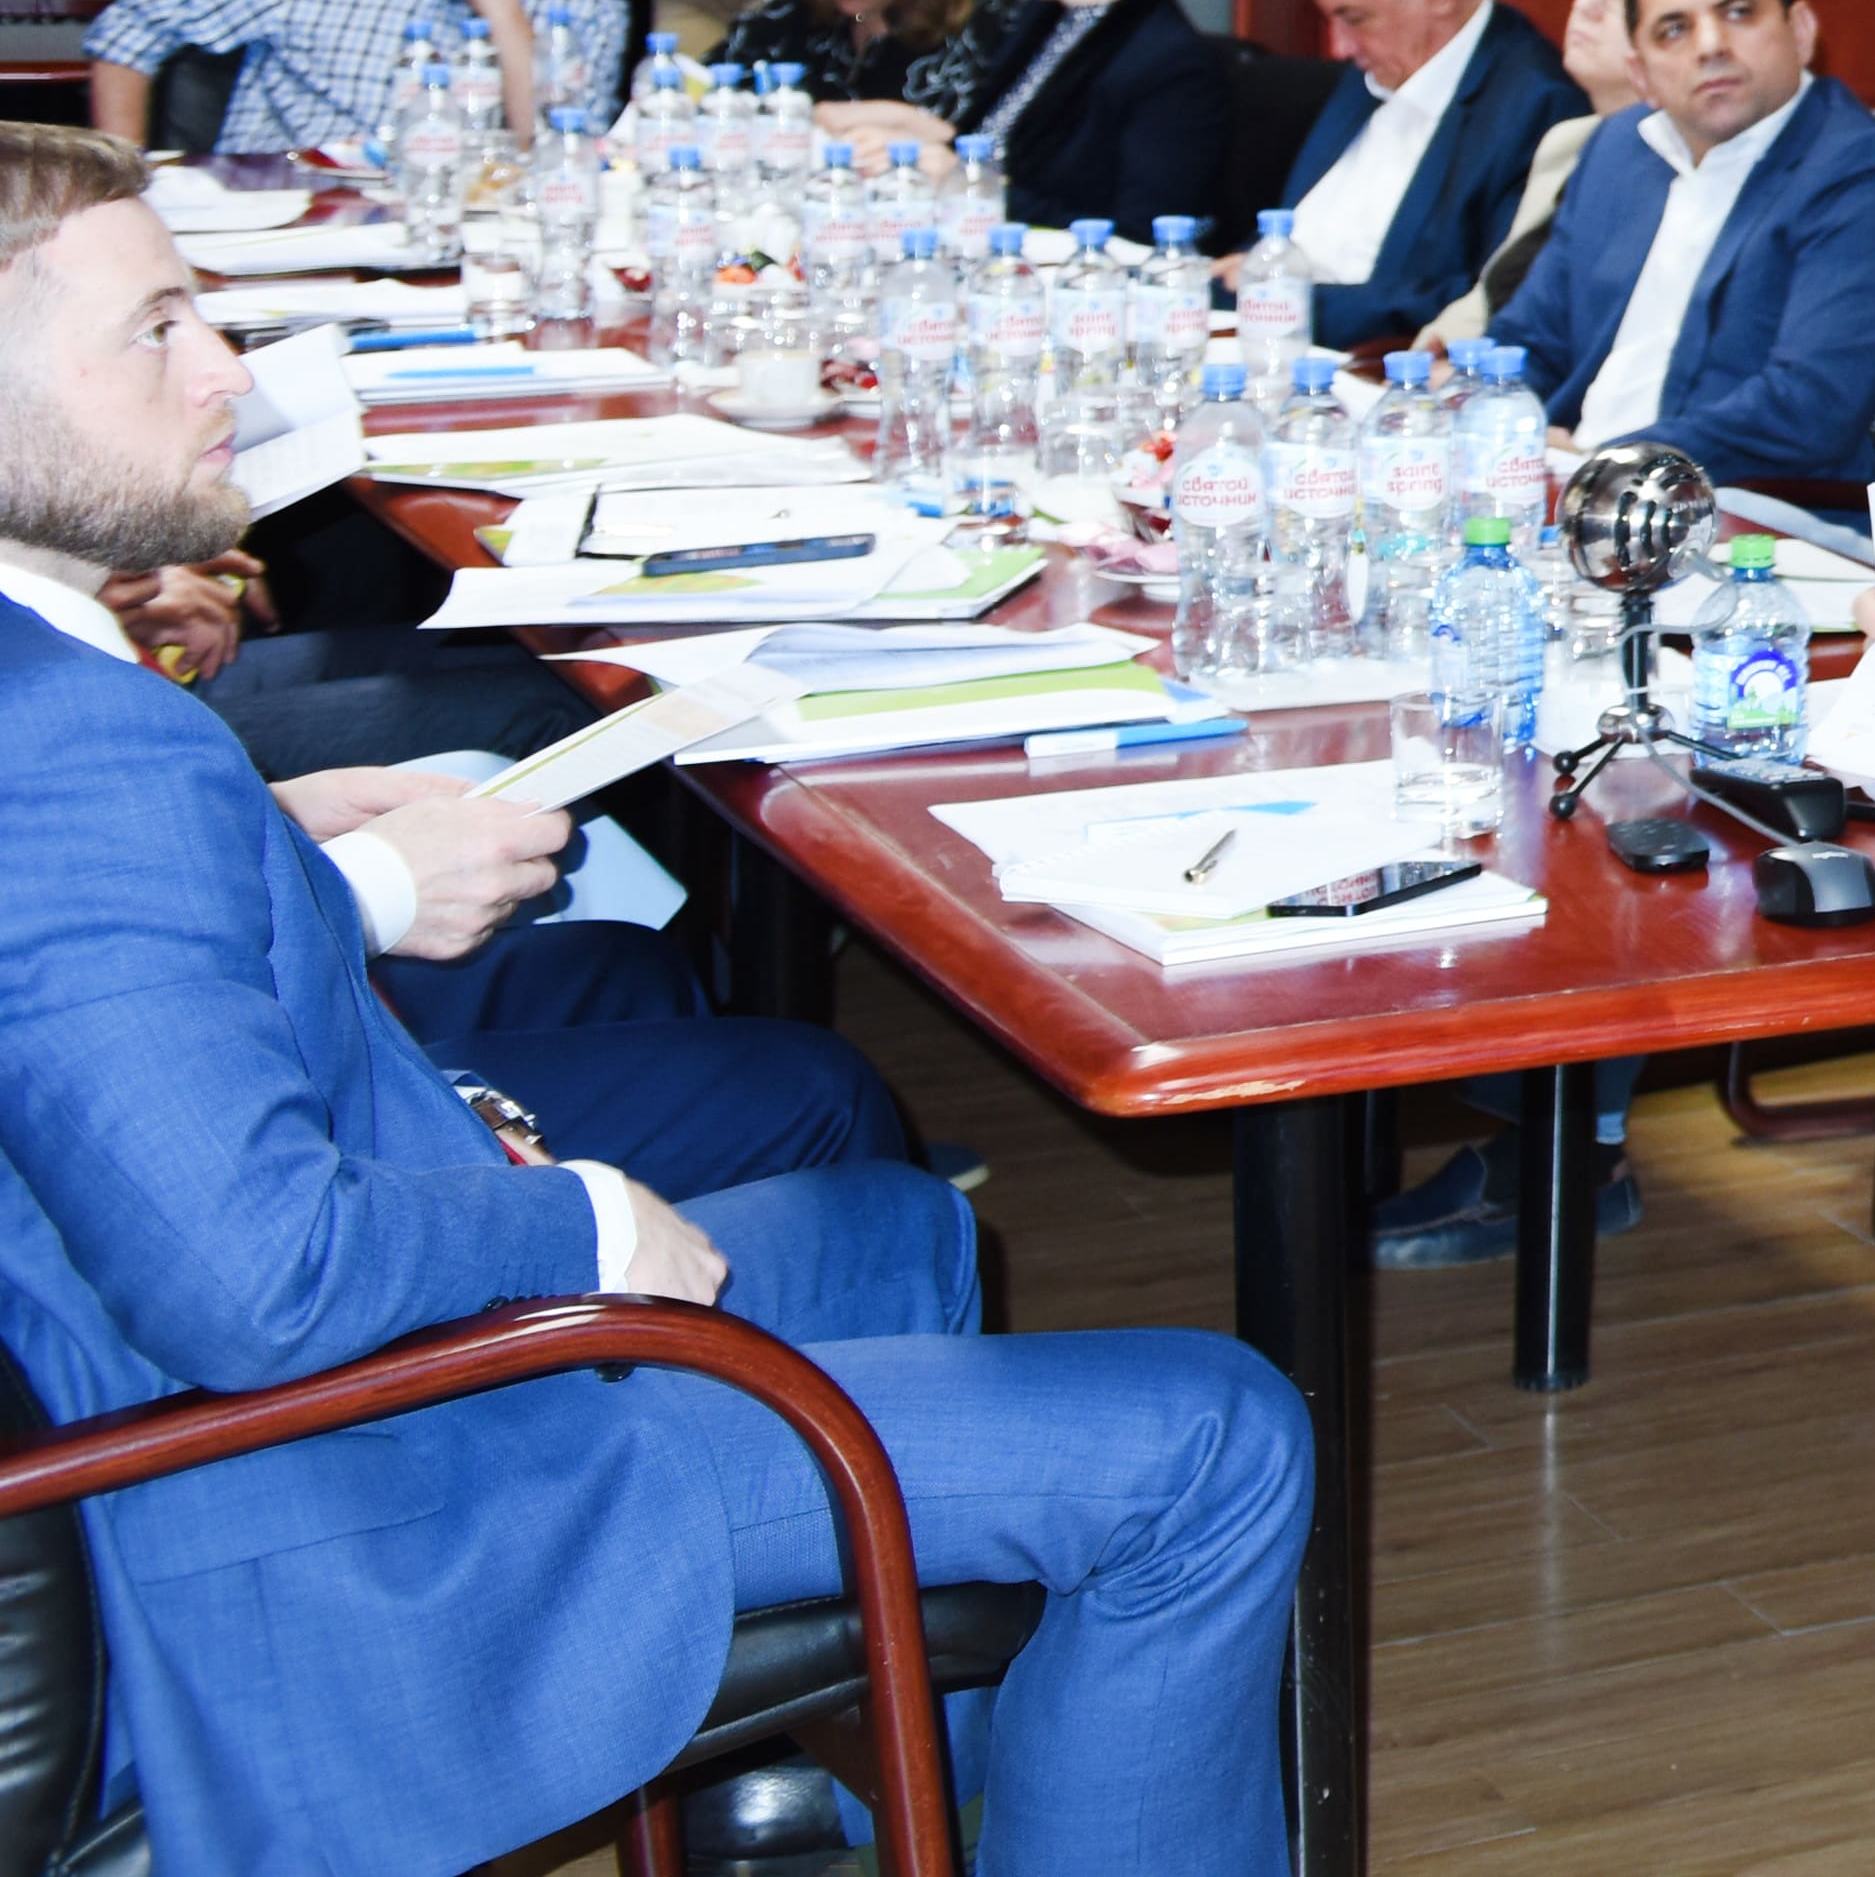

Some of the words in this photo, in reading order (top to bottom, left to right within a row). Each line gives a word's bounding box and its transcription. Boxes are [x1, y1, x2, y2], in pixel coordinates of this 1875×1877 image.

[1393, 463, 1440, 477] saint
[1182, 476, 1248, 492] святой
[1387, 477, 1443, 496] spring
[1175, 492, 1257, 508] источник
